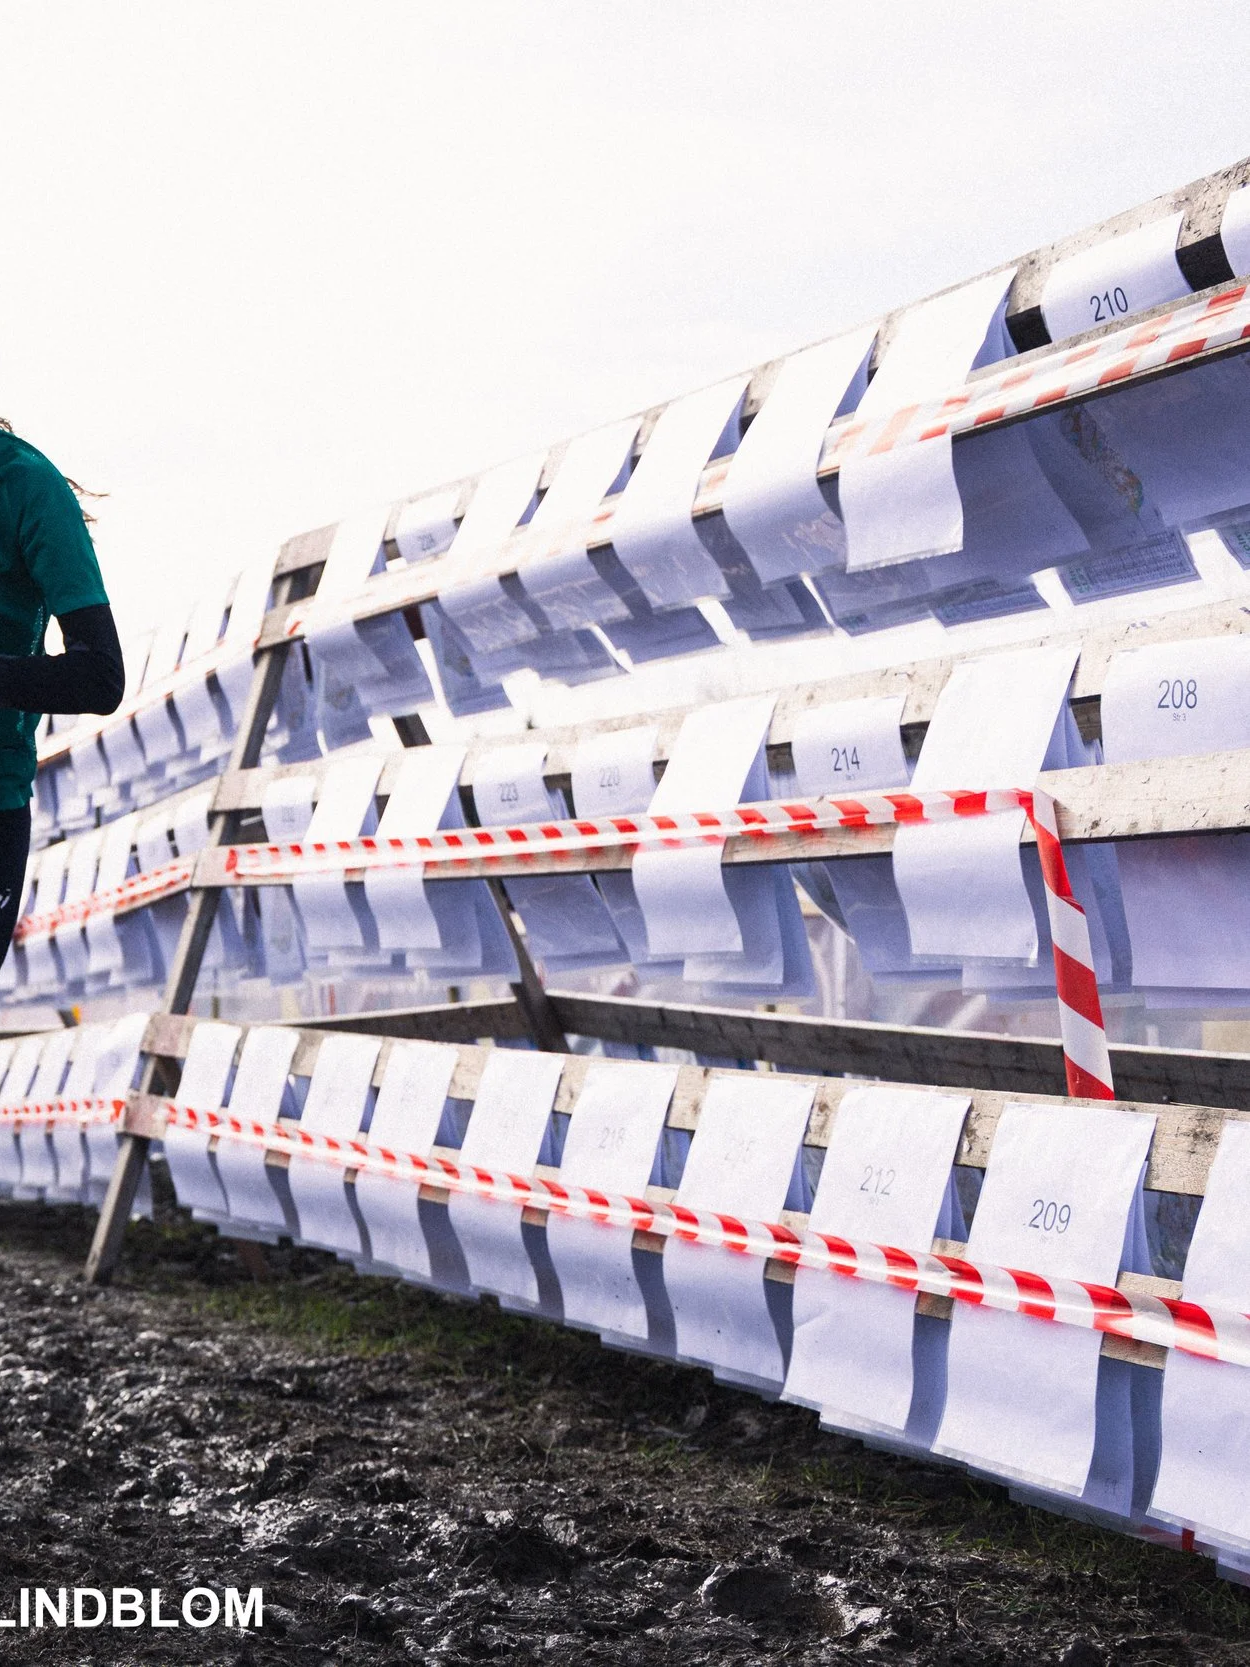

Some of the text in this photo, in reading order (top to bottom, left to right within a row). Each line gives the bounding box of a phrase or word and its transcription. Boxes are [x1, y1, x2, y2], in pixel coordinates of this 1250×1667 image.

[1090, 287, 1128, 322] 210
[1157, 679, 1198, 709] 208
[831, 746, 860, 771] 214
[860, 1165, 896, 1196] 212
[1029, 1199, 1071, 1233] 209
